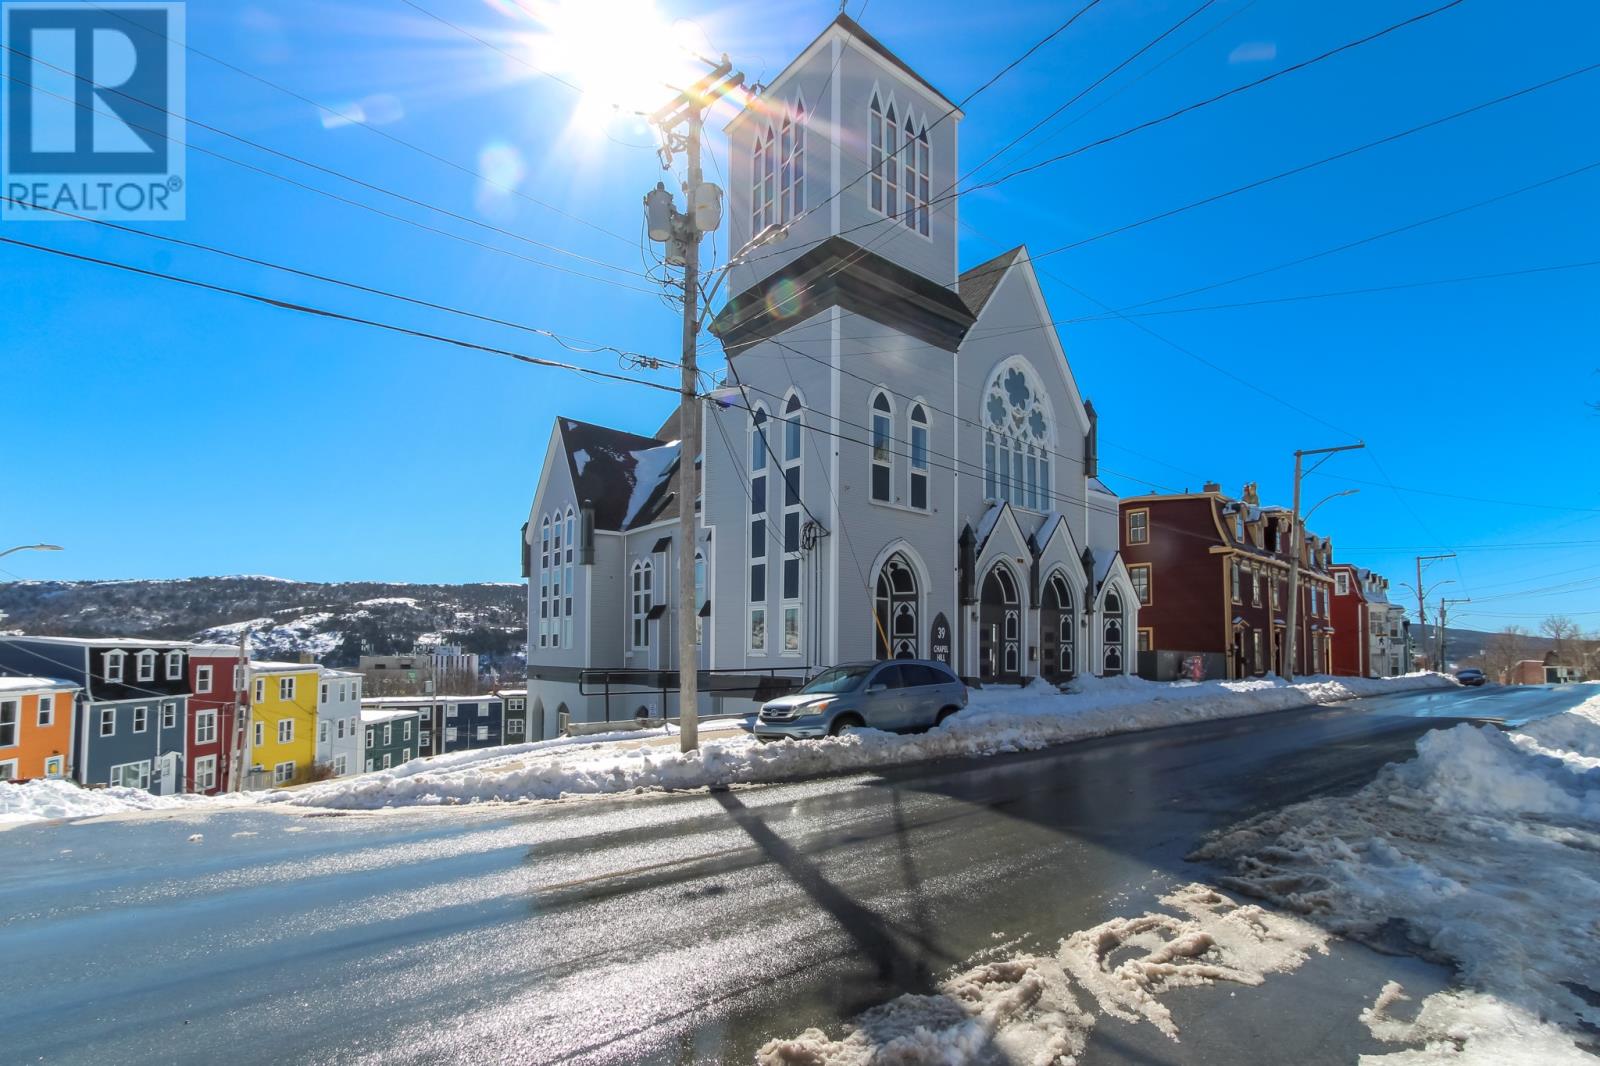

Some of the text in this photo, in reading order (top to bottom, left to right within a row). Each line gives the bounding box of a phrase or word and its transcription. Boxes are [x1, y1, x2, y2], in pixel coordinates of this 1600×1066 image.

[937, 627, 946, 639] 39
[933, 645, 949, 653] CHAPEL
[936, 654, 946, 662] HILL
